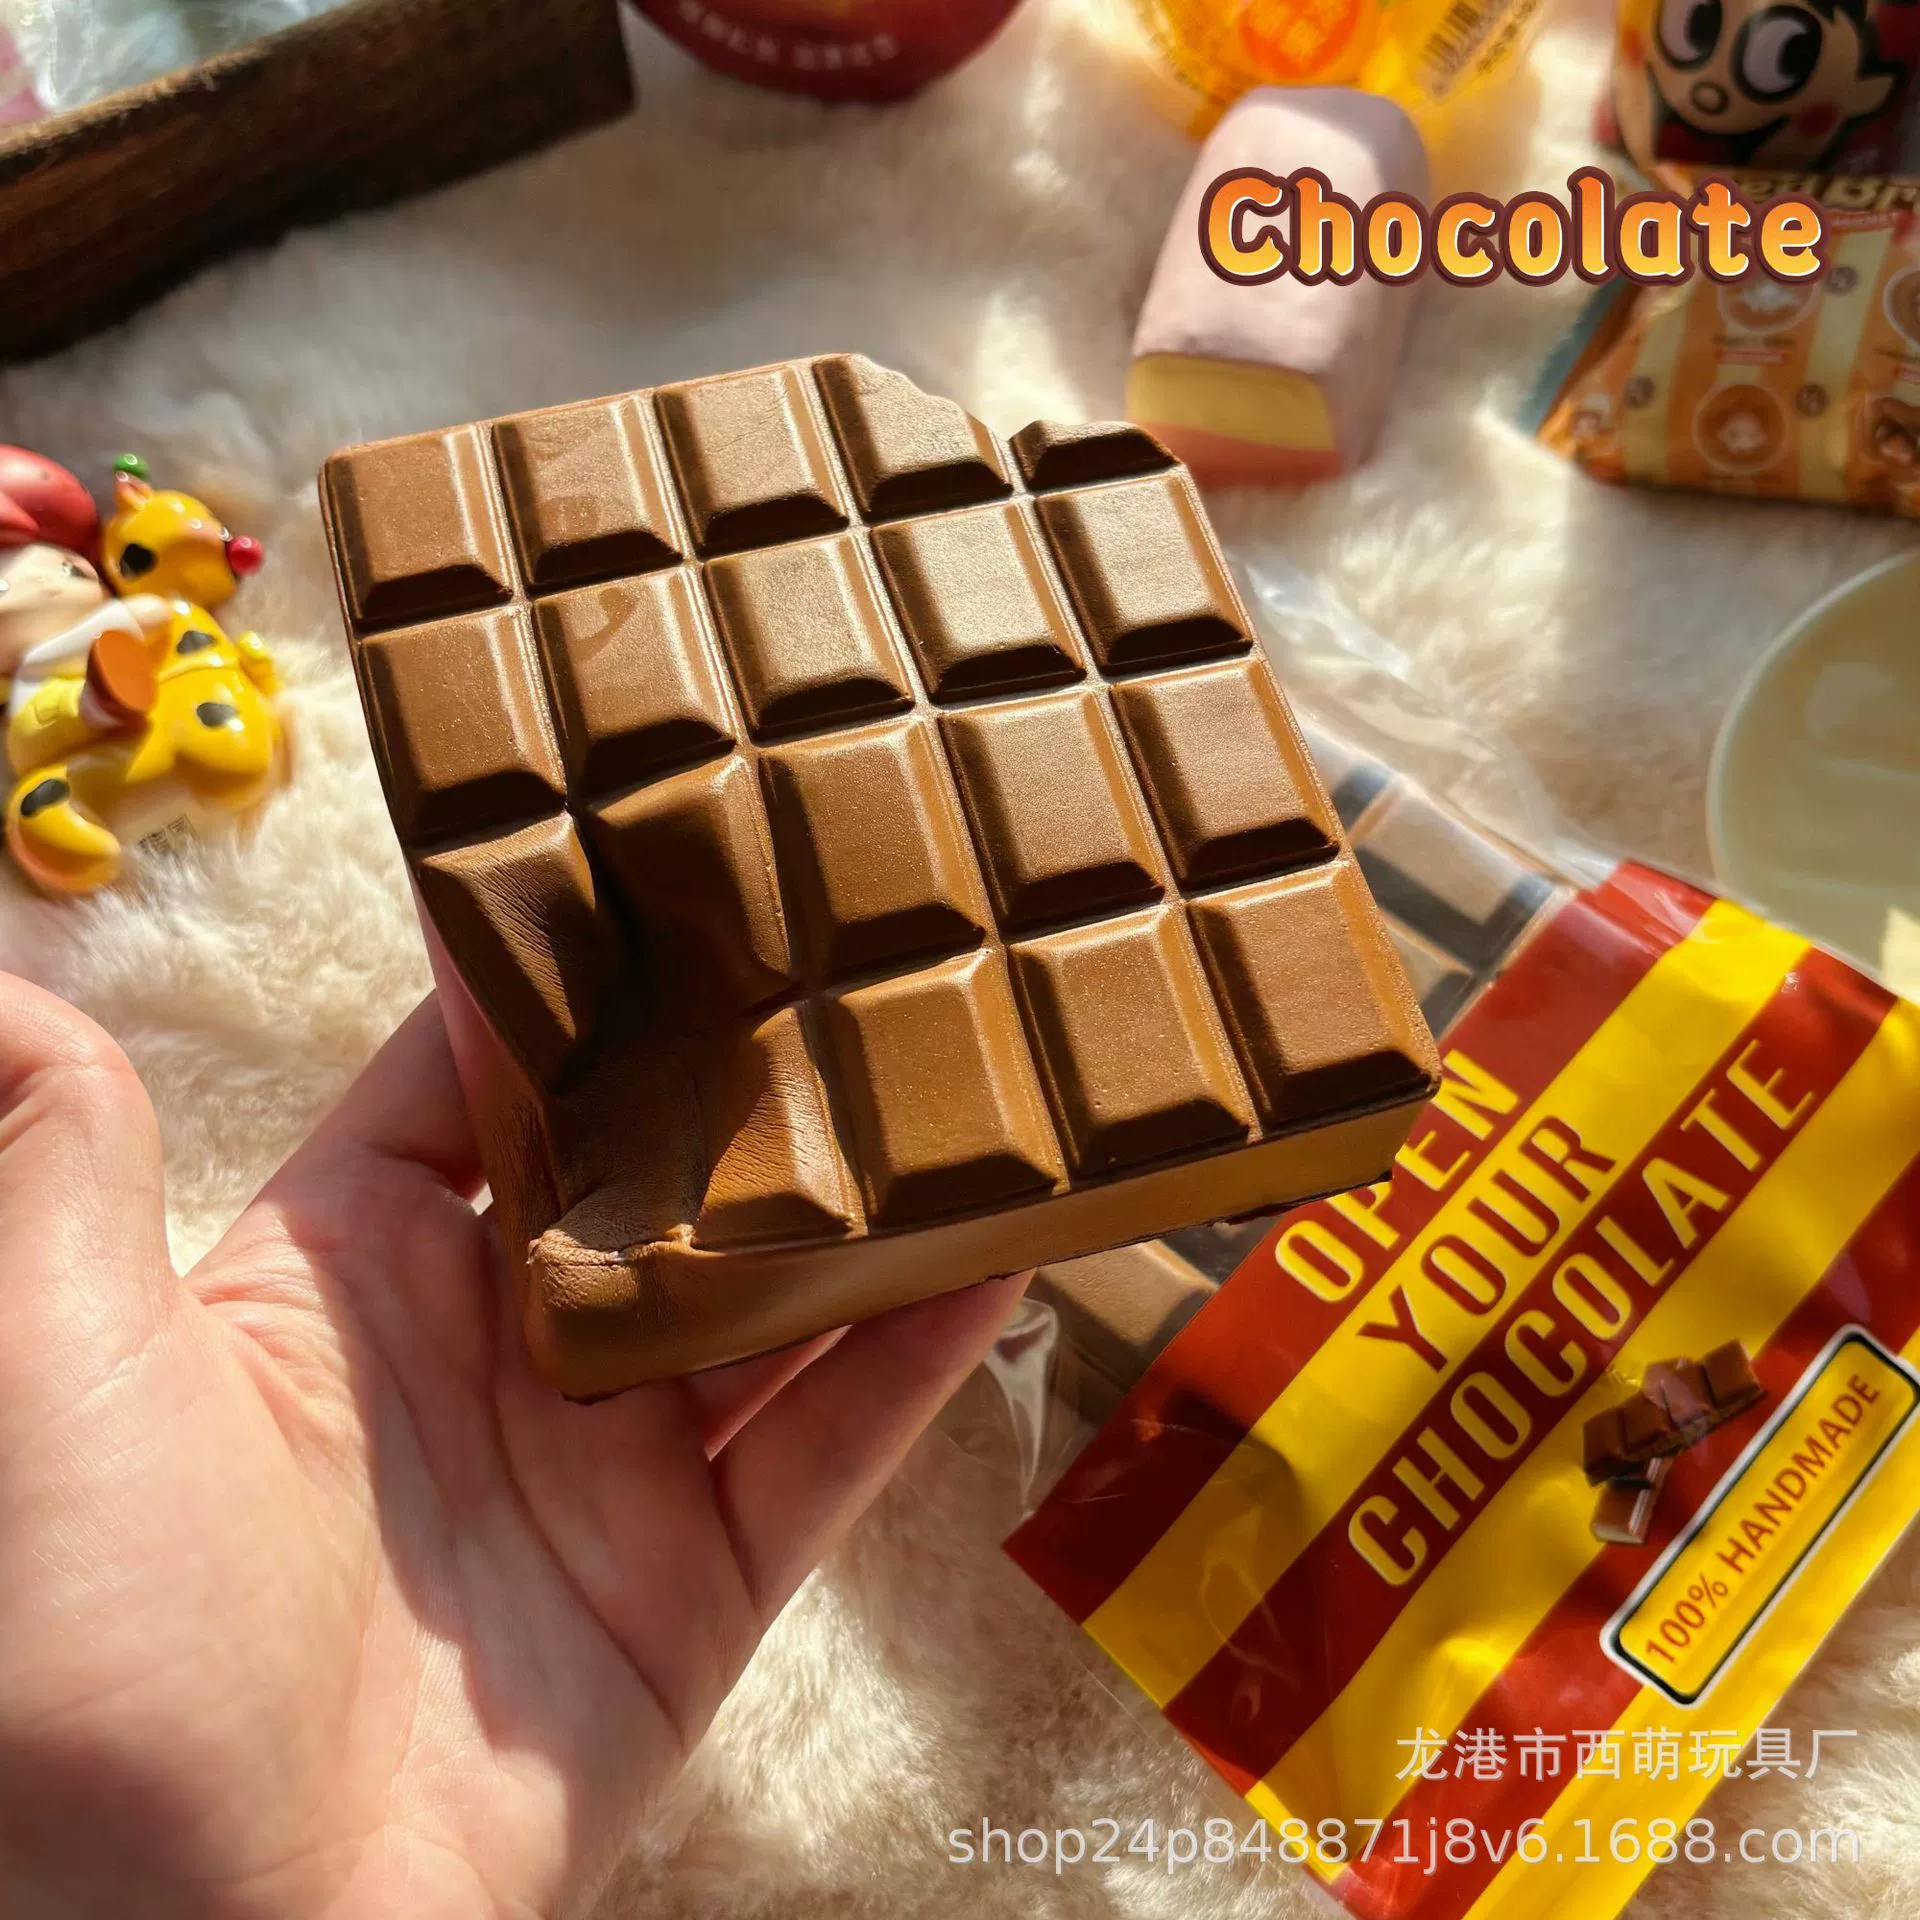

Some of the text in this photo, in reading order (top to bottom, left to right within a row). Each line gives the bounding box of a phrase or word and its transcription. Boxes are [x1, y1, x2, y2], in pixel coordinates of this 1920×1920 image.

[1347, 1038, 1814, 1587] CHOCOLATE
[1355, 1115, 1617, 1375] YOUR
[1645, 1373, 1881, 1666] 100% HANDMADE
